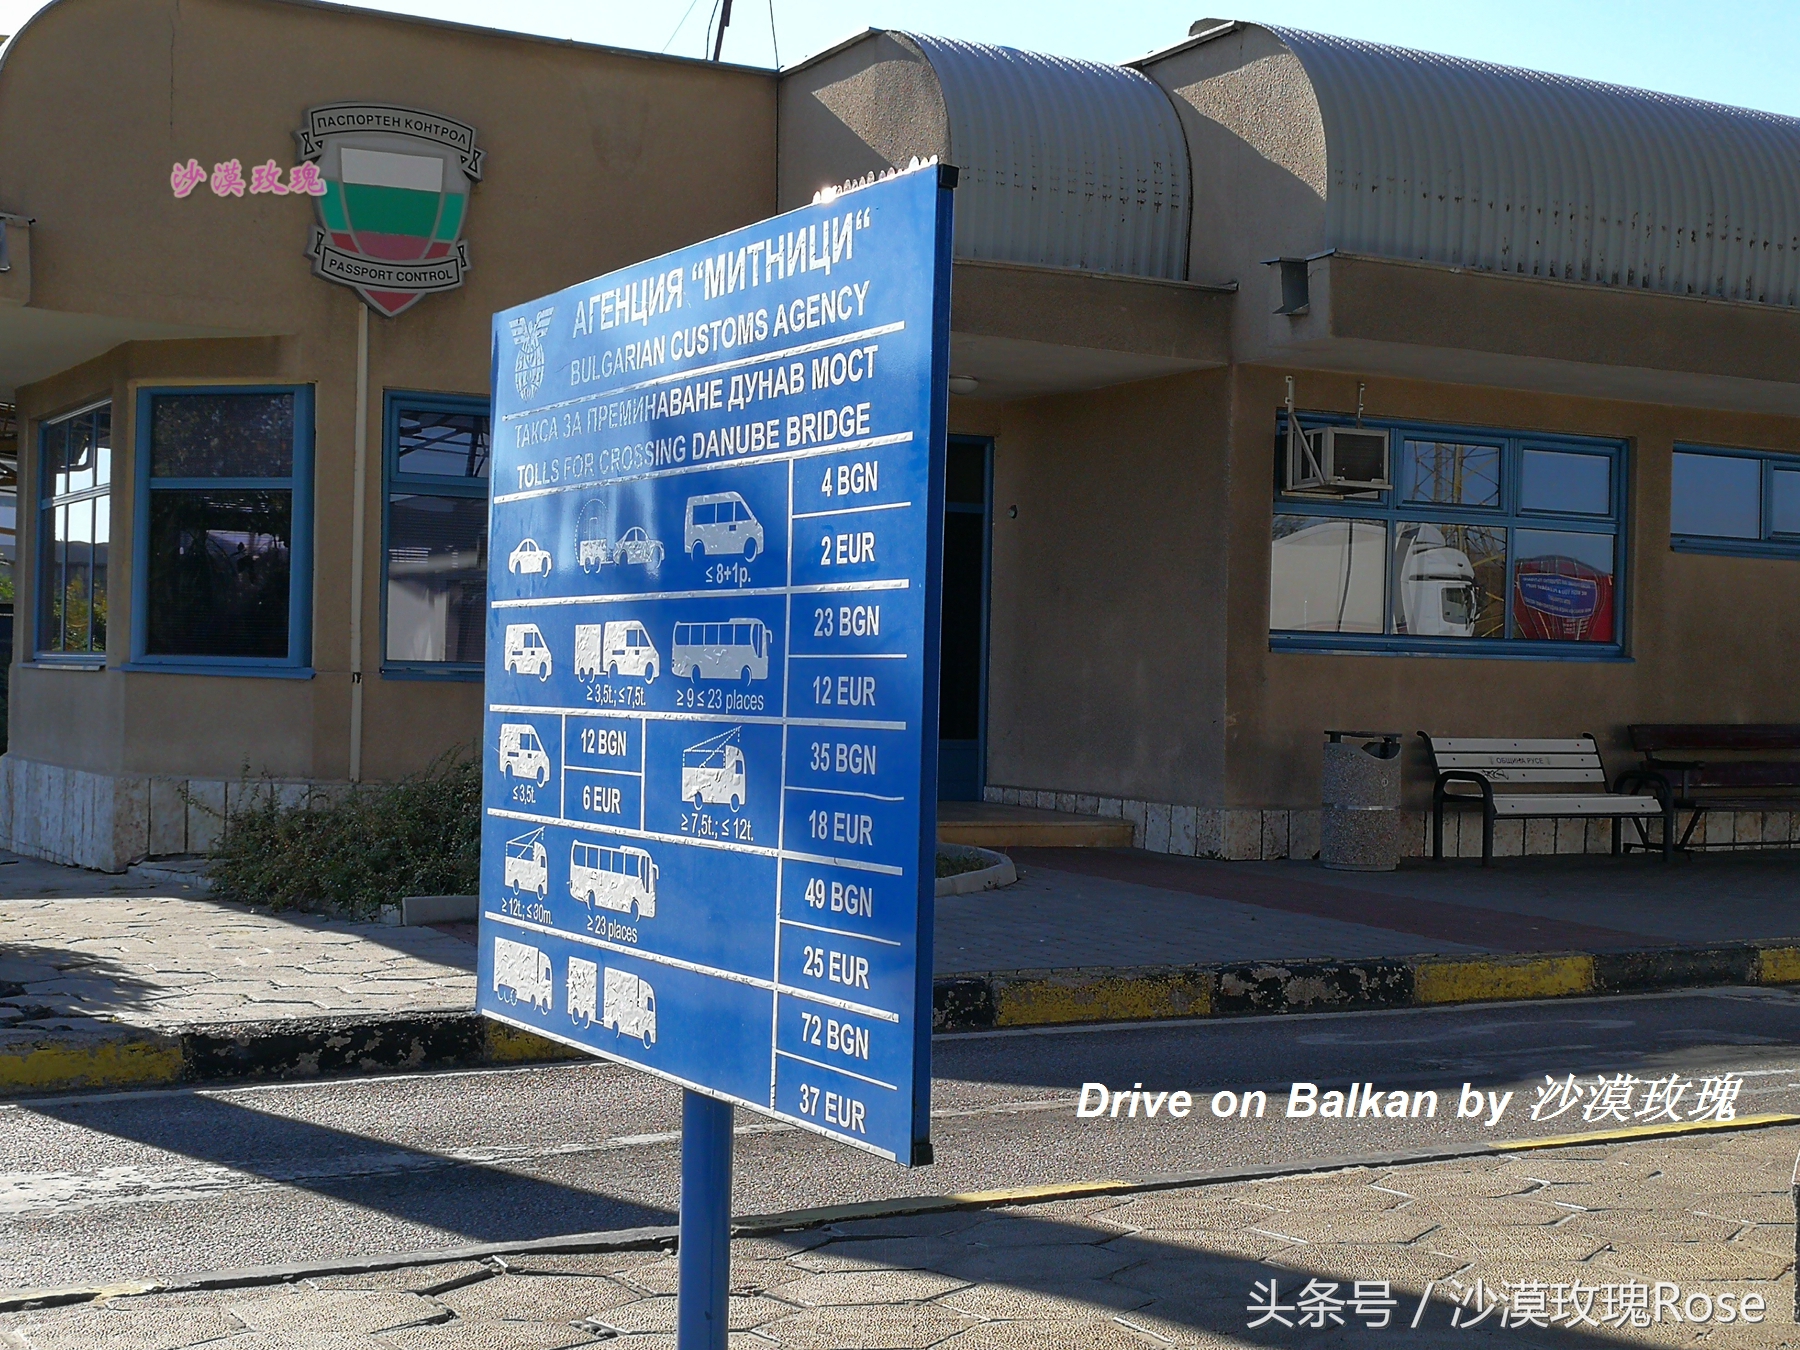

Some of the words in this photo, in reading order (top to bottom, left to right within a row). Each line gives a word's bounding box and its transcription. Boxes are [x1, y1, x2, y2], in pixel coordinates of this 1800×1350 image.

[317, 114, 401, 128] ПАСПОРТЕН
[405, 118, 467, 144] КОНТРОЛ
[329, 258, 393, 280] PASSPORT
[396, 269, 453, 282] CONTROL
[572, 267, 684, 338] АГЕНЦИЯ
[570, 334, 666, 386] BULGARIAN
[670, 308, 768, 361] CUSTOMS
[773, 280, 870, 338] AGENCY
[514, 417, 559, 448] ТАКСА
[563, 408, 582, 438] ЗА
[587, 378, 723, 433] ПРЕМИНАВАНЕ
[727, 362, 805, 412] ДУНАВ
[811, 344, 879, 390] МОСТ
[516, 458, 559, 489] TOLLS
[563, 451, 594, 479] FOR
[599, 434, 686, 475] CROSSING
[692, 418, 781, 460] DANUBE
[786, 401, 871, 446] BRIDGE
[821, 467, 833, 497] 4
[837, 460, 878, 496] BGN
[820, 535, 832, 566] 2
[836, 531, 876, 564] EUR
[813, 607, 834, 637] 23
[839, 605, 880, 637] BGN
[707, 688, 722, 710] 23
[725, 690, 765, 714] places
[813, 675, 832, 705] 12
[837, 676, 876, 706] EUR
[580, 728, 595, 753] 12
[598, 729, 627, 757] BGN
[810, 742, 830, 772] 35
[835, 743, 876, 775] BGN
[1527, 757, 1544, 765] РУСЕ
[583, 785, 591, 811] 6
[593, 787, 621, 815] EUR
[808, 809, 828, 840] 18
[833, 812, 873, 846] EUR
[804, 877, 826, 909] 49
[831, 881, 873, 918] BGN
[595, 914, 606, 936] 23
[608, 918, 638, 943] places
[803, 945, 824, 978] 25
[829, 950, 870, 990] EUR
[801, 1011, 822, 1046] 72
[826, 1018, 870, 1060] BGN
[799, 1083, 820, 1117] 37
[824, 1090, 866, 1135] EUR
